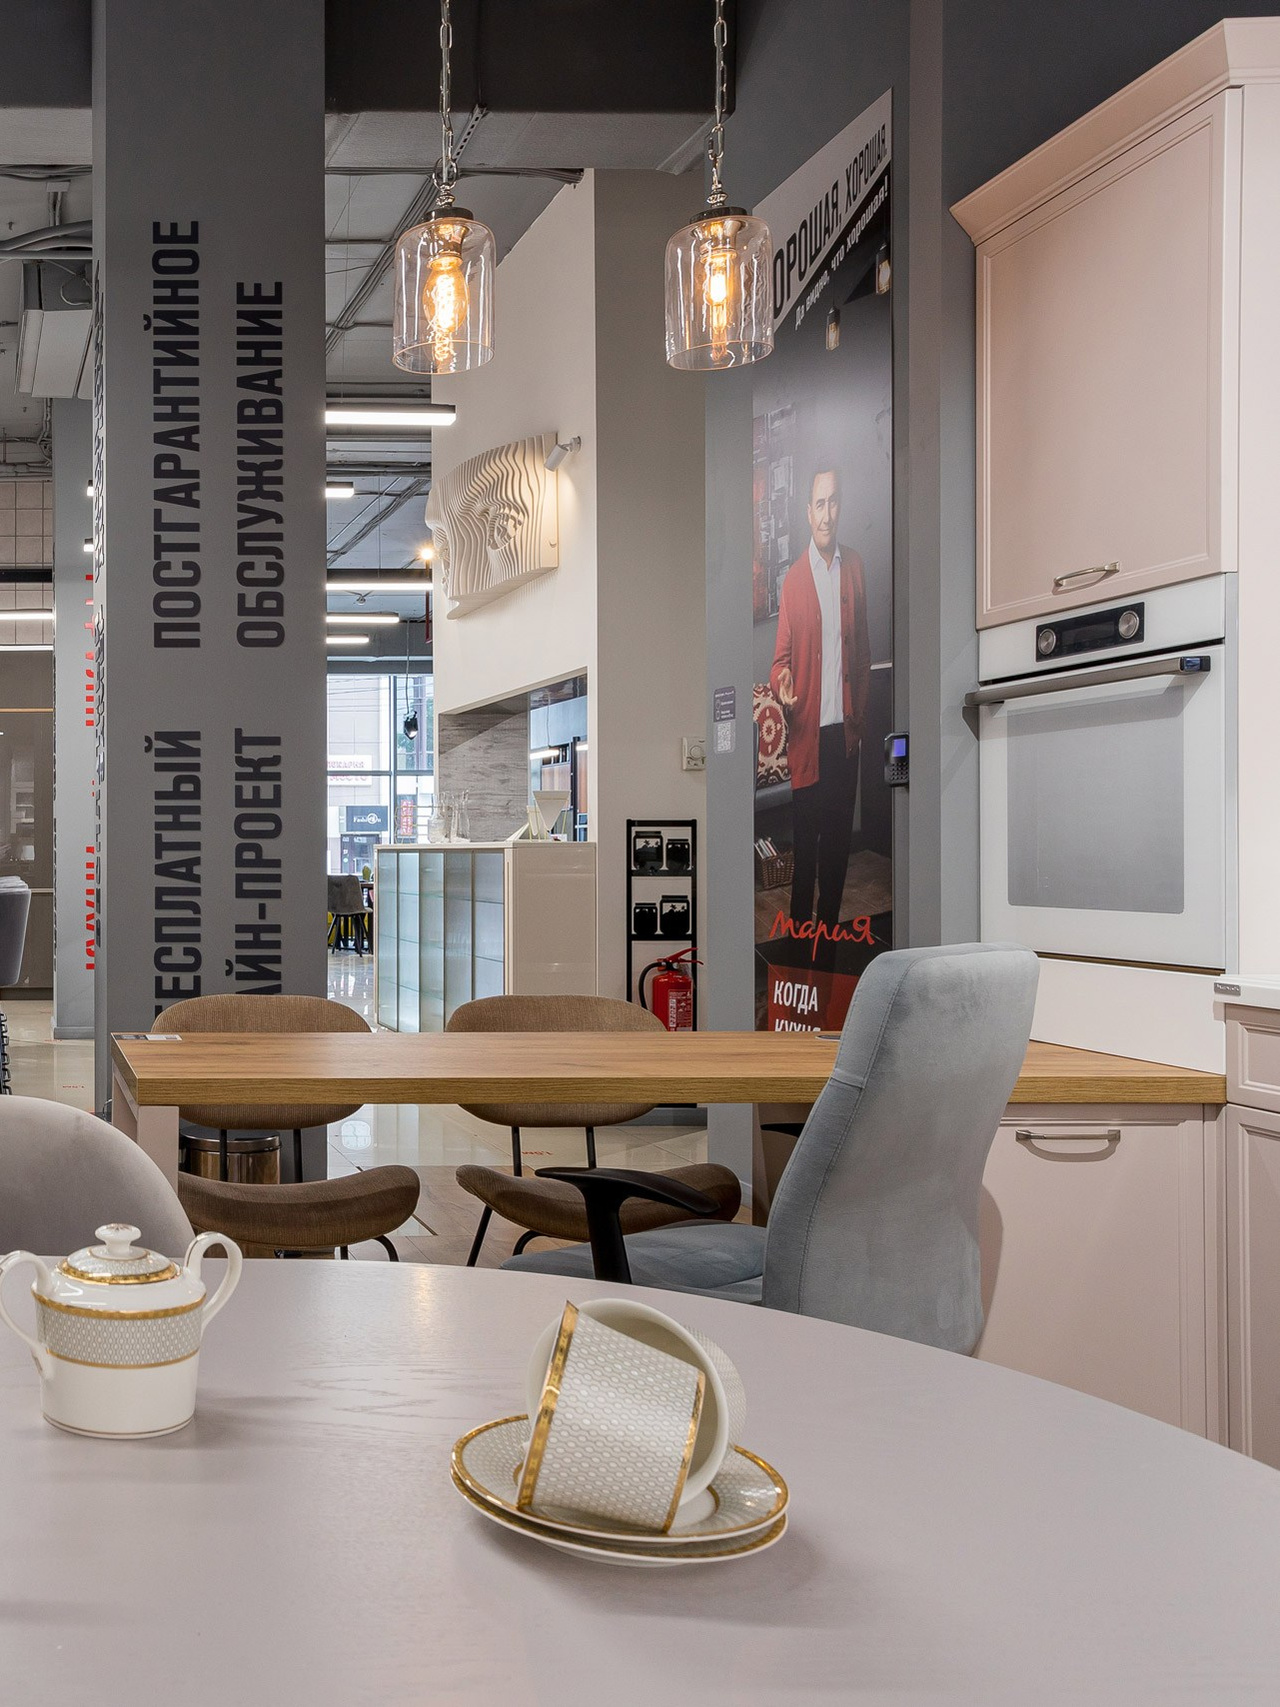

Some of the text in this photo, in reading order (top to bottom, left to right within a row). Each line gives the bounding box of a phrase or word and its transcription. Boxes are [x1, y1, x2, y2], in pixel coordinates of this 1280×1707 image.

[830, 243, 846, 272] что
[845, 174, 889, 253] хорошая!
[142, 219, 202, 649] ПОСТГАРАНТИЙНОЕ
[235, 280, 286, 649] ОБСЛУЖИВАНИЕ
[143, 729, 203, 1020] ЕСПЛАТНЫЙ
[773, 980, 819, 1016] КОГДА
